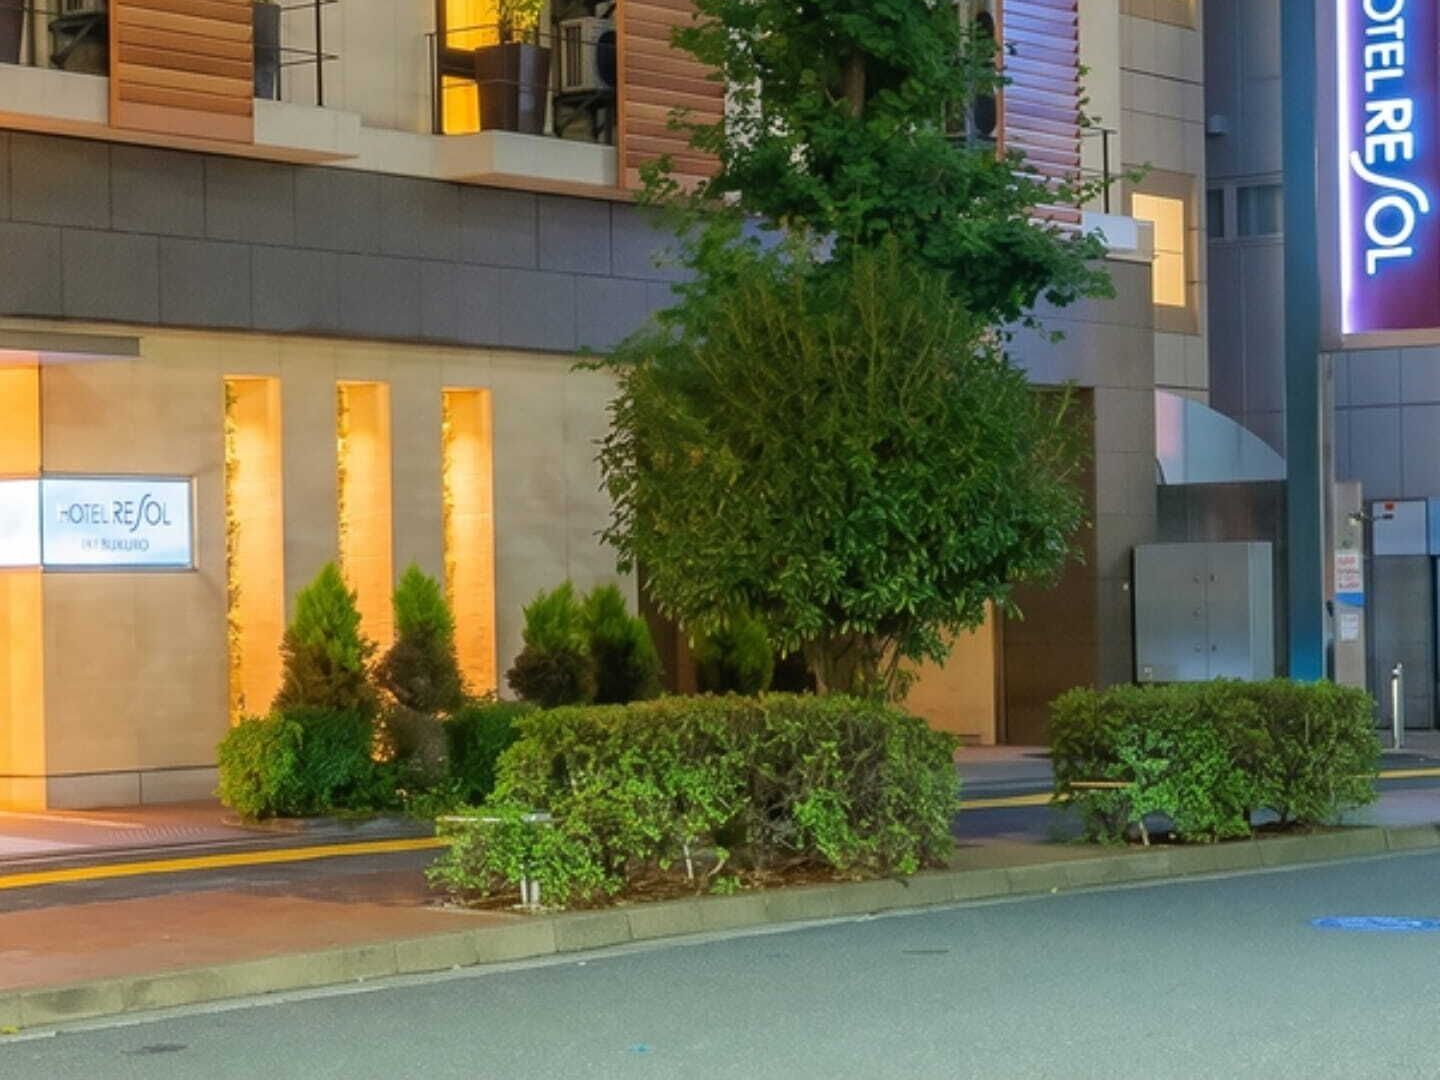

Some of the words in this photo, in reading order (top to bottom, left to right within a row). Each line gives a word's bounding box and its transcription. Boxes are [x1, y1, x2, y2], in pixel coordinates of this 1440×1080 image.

[1349, 97, 1429, 275] RESOL
[59, 502, 110, 524] HOTEL
[112, 492, 172, 533] RESOL
